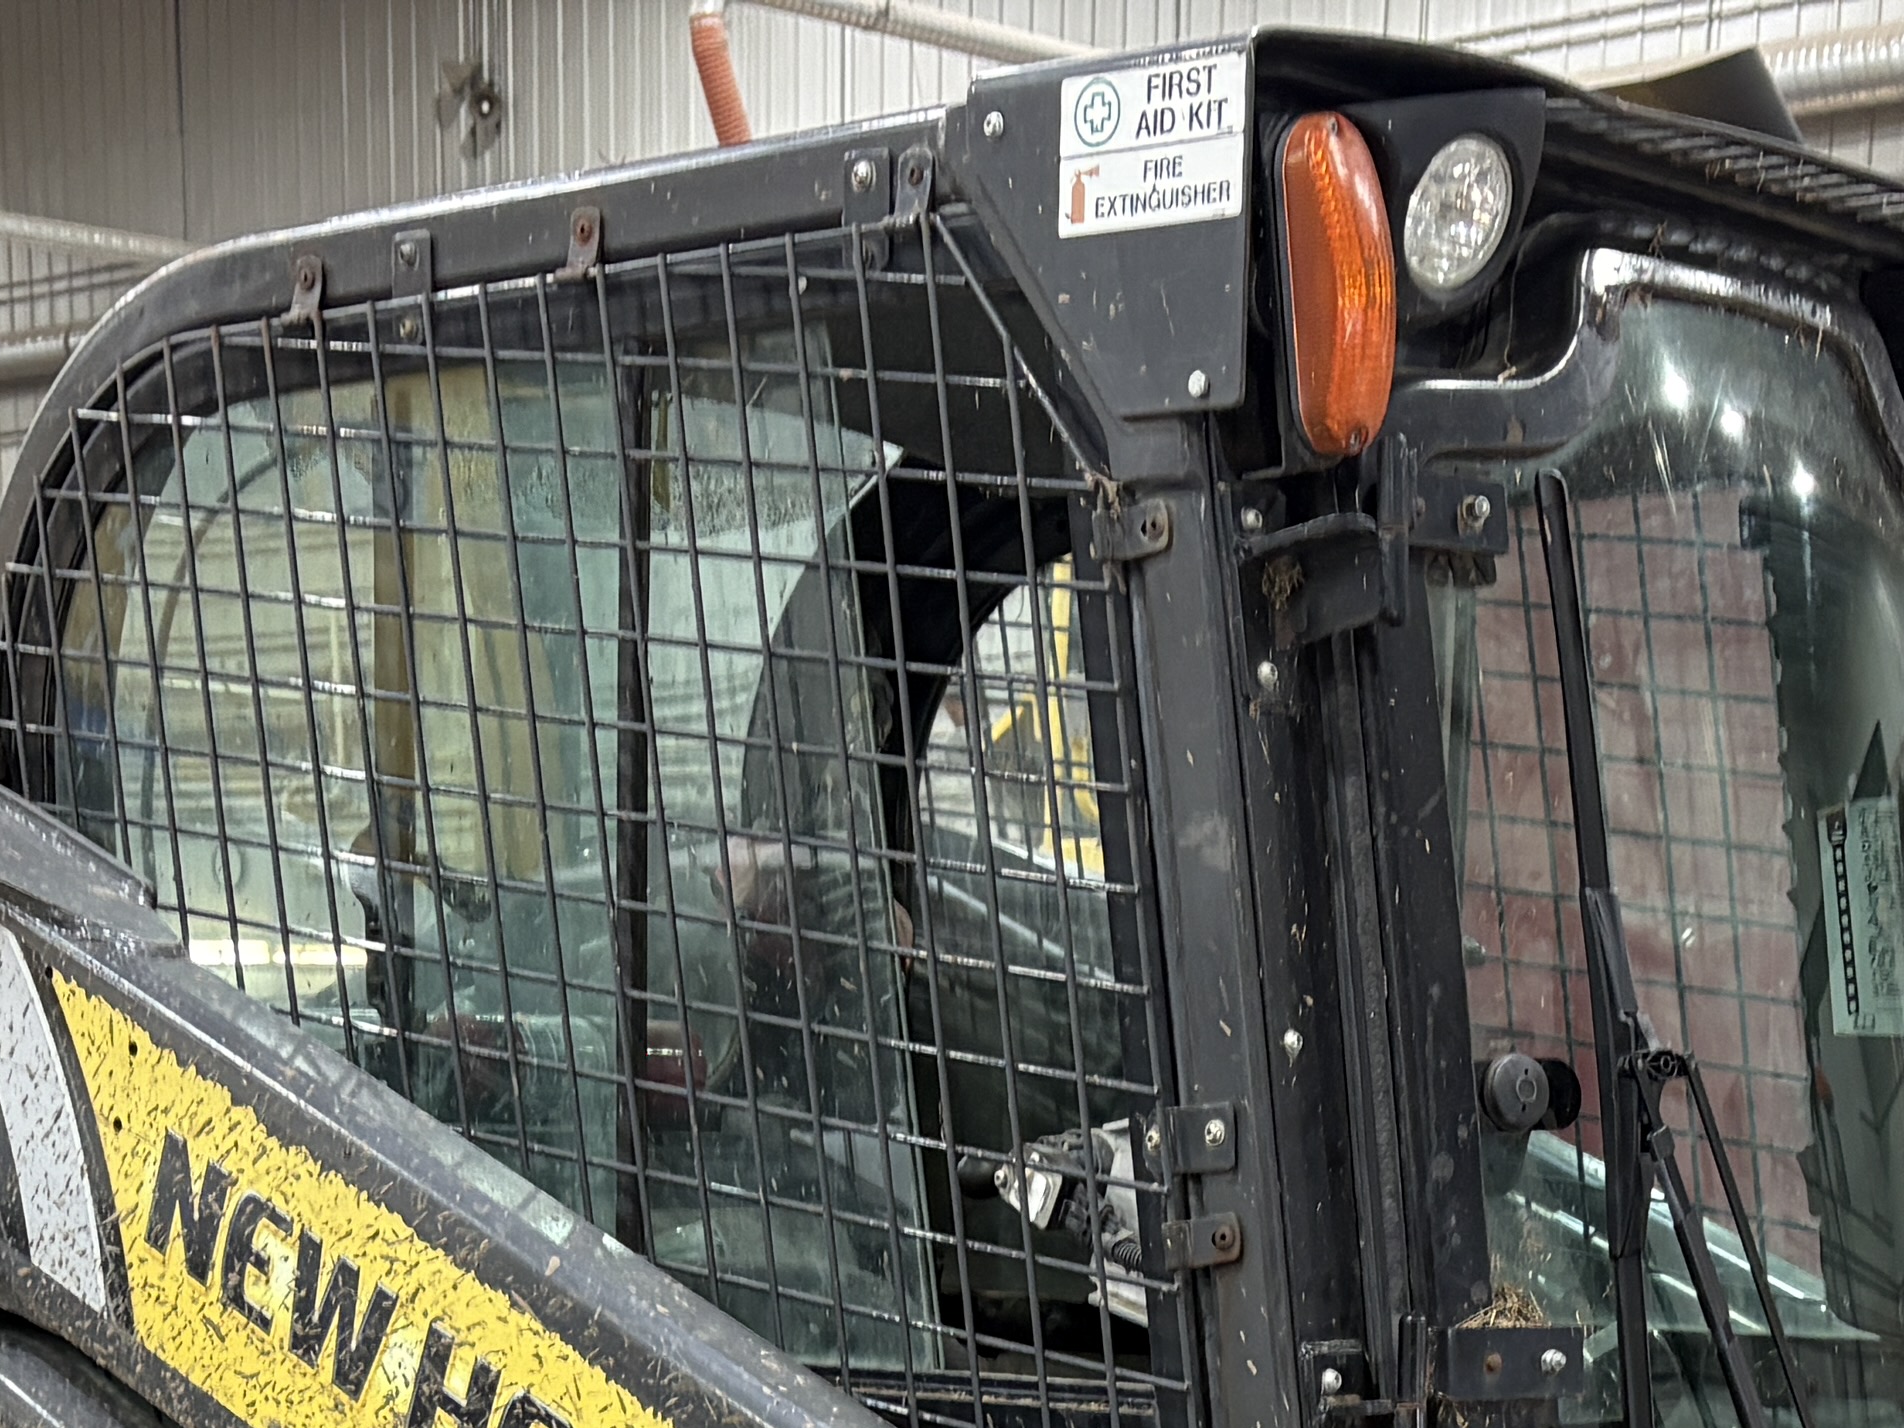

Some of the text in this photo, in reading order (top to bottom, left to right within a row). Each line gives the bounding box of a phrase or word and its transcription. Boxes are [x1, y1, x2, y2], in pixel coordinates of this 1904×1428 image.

[1146, 64, 1217, 104] FIRST
[1135, 97, 1229, 139] AID KIT
[1142, 155, 1183, 183] FIRE
[1095, 180, 1231, 219] EXTINGUISHER
[144, 1126, 399, 1400] NEW
